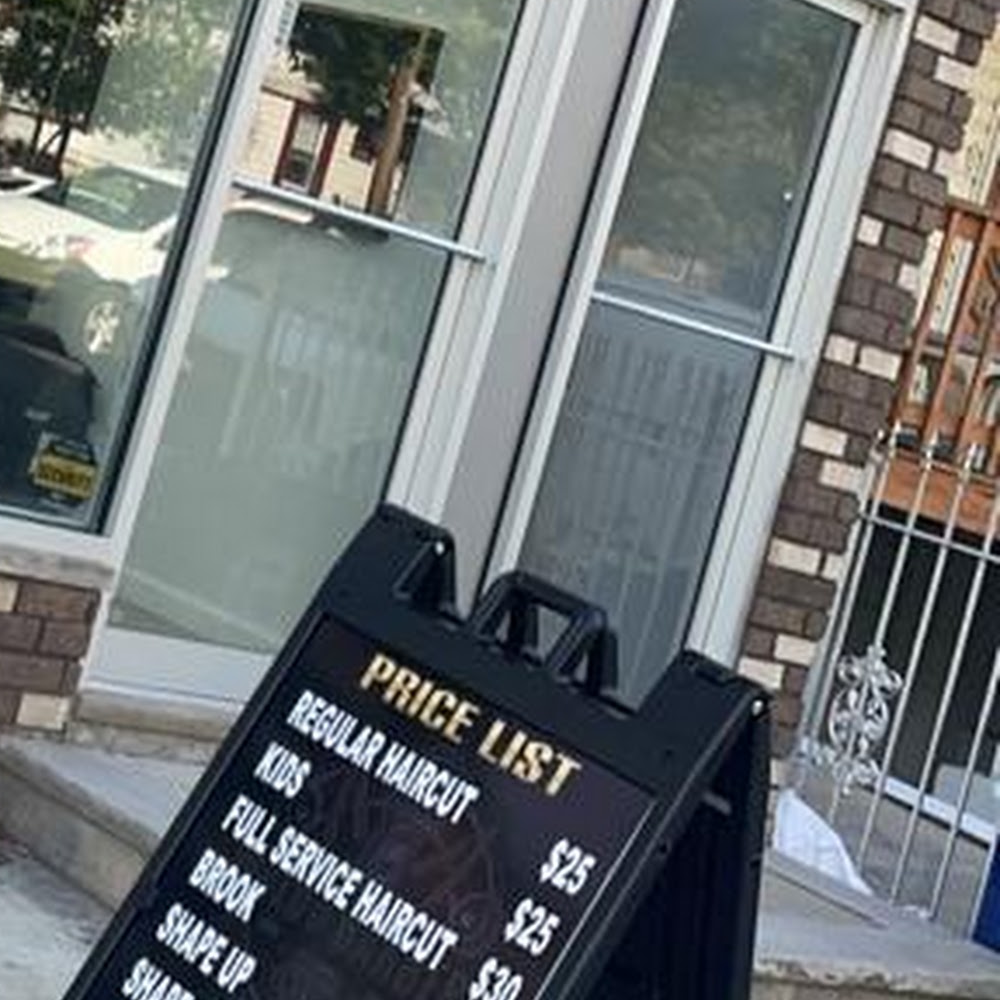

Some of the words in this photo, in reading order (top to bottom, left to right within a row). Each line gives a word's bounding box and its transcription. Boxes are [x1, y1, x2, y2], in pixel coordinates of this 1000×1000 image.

[286, 689, 387, 772] REGULAR
[374, 742, 481, 824] HAIRCUT
[539, 838, 596, 896] $25
[360, 653, 481, 744] PRICE
[477, 719, 582, 797] LIST
[188, 848, 267, 923] BROOK
[221, 794, 278, 855] FULL
[269, 826, 364, 911] SERVICE
[350, 879, 460, 971] HAIRCUT
[469, 957, 524, 1000] $30
[253, 741, 312, 798] KIDS
[504, 898, 561, 957] $25
[155, 902, 230, 976] SHAPE
[217, 946, 258, 994] UP
